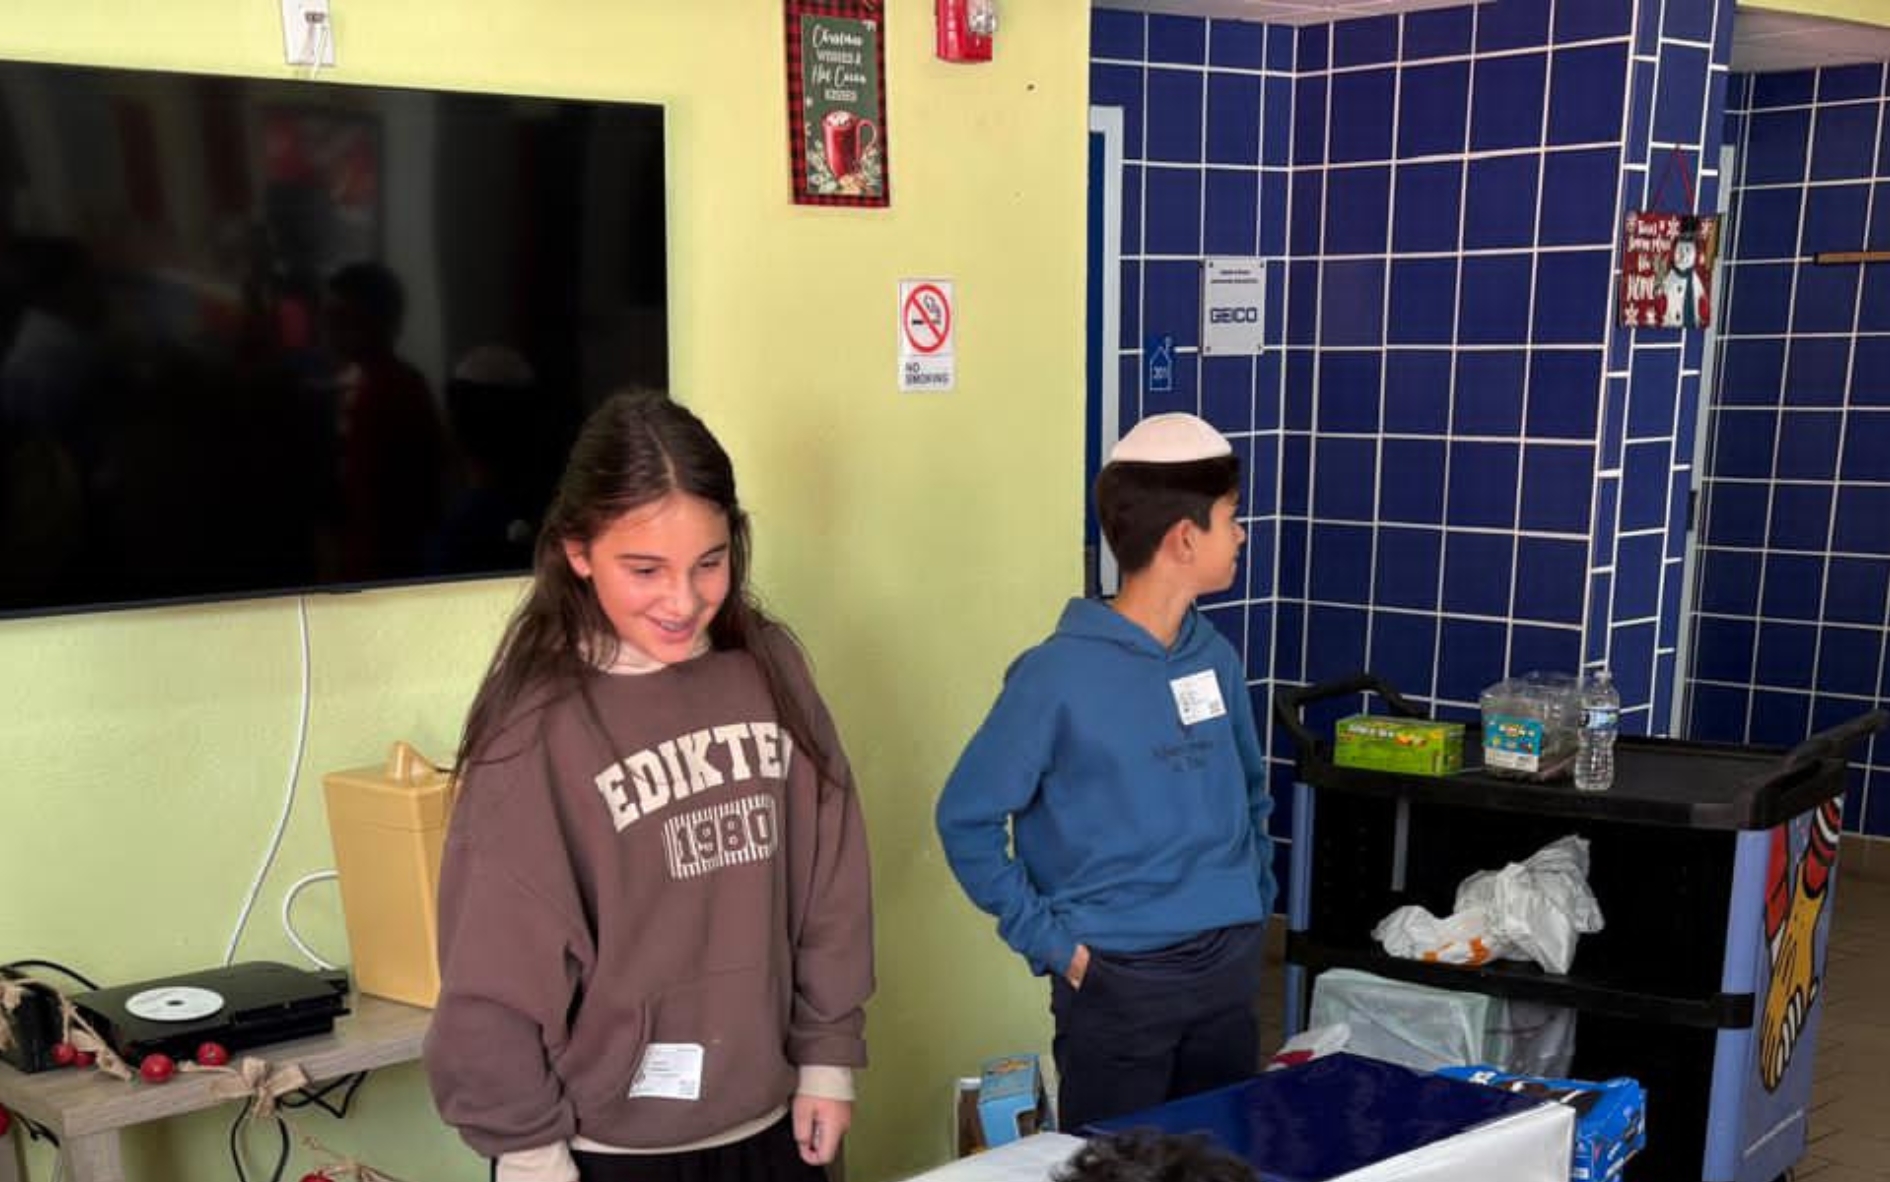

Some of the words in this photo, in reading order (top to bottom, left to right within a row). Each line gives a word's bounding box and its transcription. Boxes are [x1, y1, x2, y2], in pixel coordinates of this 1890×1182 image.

[905, 362, 920, 373] NO
[905, 374, 949, 386] SMOKING
[675, 806, 775, 866] 1980
